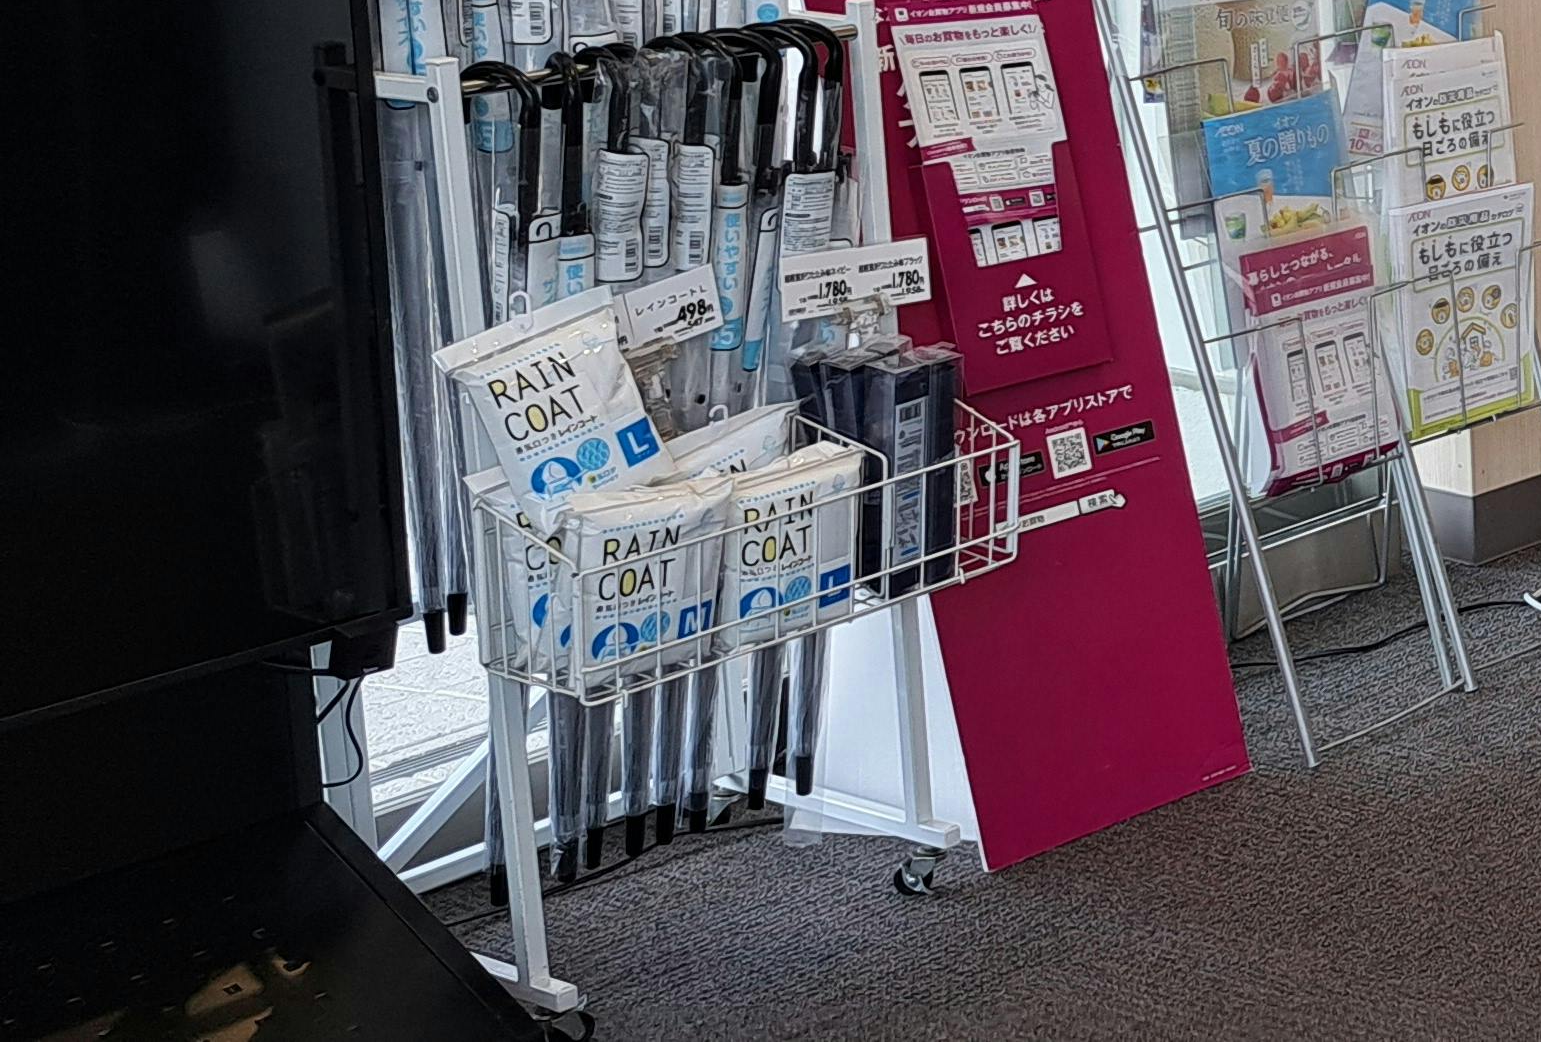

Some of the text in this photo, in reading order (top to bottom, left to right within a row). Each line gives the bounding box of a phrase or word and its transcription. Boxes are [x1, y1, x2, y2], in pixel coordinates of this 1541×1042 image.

[1411, 110, 1496, 140] もしもに役立つ
[1419, 231, 1513, 265] もしもに役立つ
[977, 302, 1085, 339] こちらのチラシを
[1001, 290, 1054, 311] 詳しくは
[994, 324, 1075, 355] ご覧ください
[487, 351, 577, 409] RAIN
[504, 383, 585, 442] COAT
[743, 495, 815, 535] RAIN
[602, 525, 681, 566] RAIN
[741, 524, 812, 567] COAT
[598, 558, 677, 602] COAT
